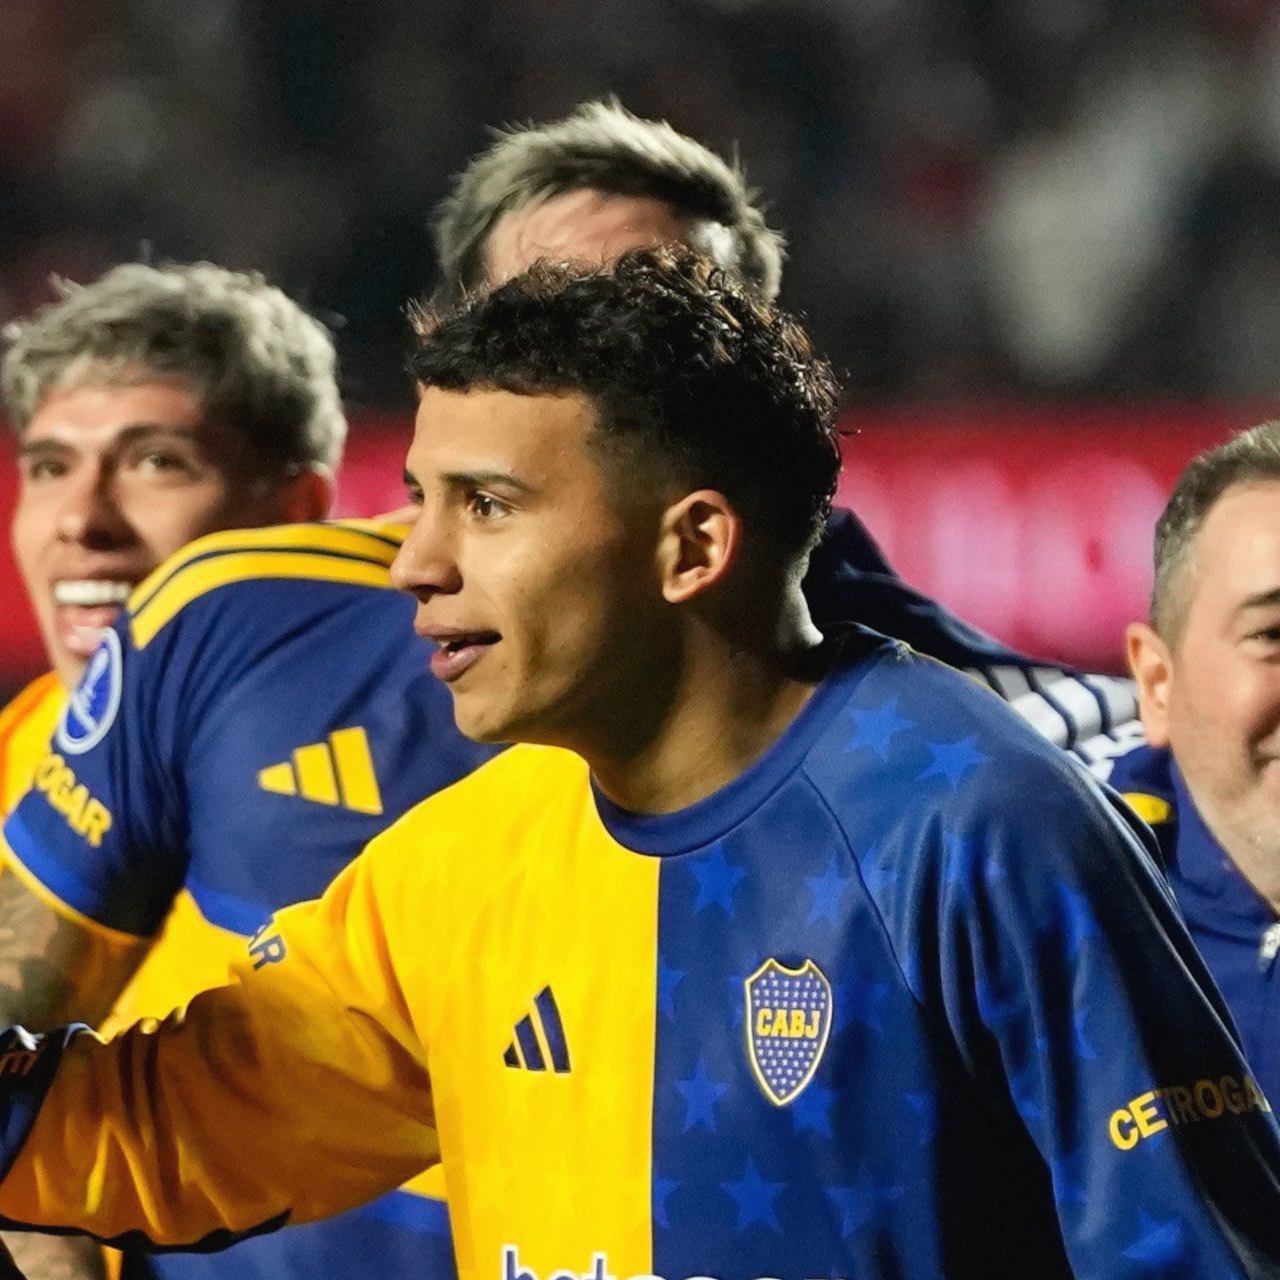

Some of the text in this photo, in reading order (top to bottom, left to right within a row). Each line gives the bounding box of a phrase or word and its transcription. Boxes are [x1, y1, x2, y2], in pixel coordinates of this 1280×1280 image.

[35, 753, 113, 847] OGAR
[756, 1008, 821, 1038] CABJ
[1108, 1073, 1272, 1151] CETROGA
